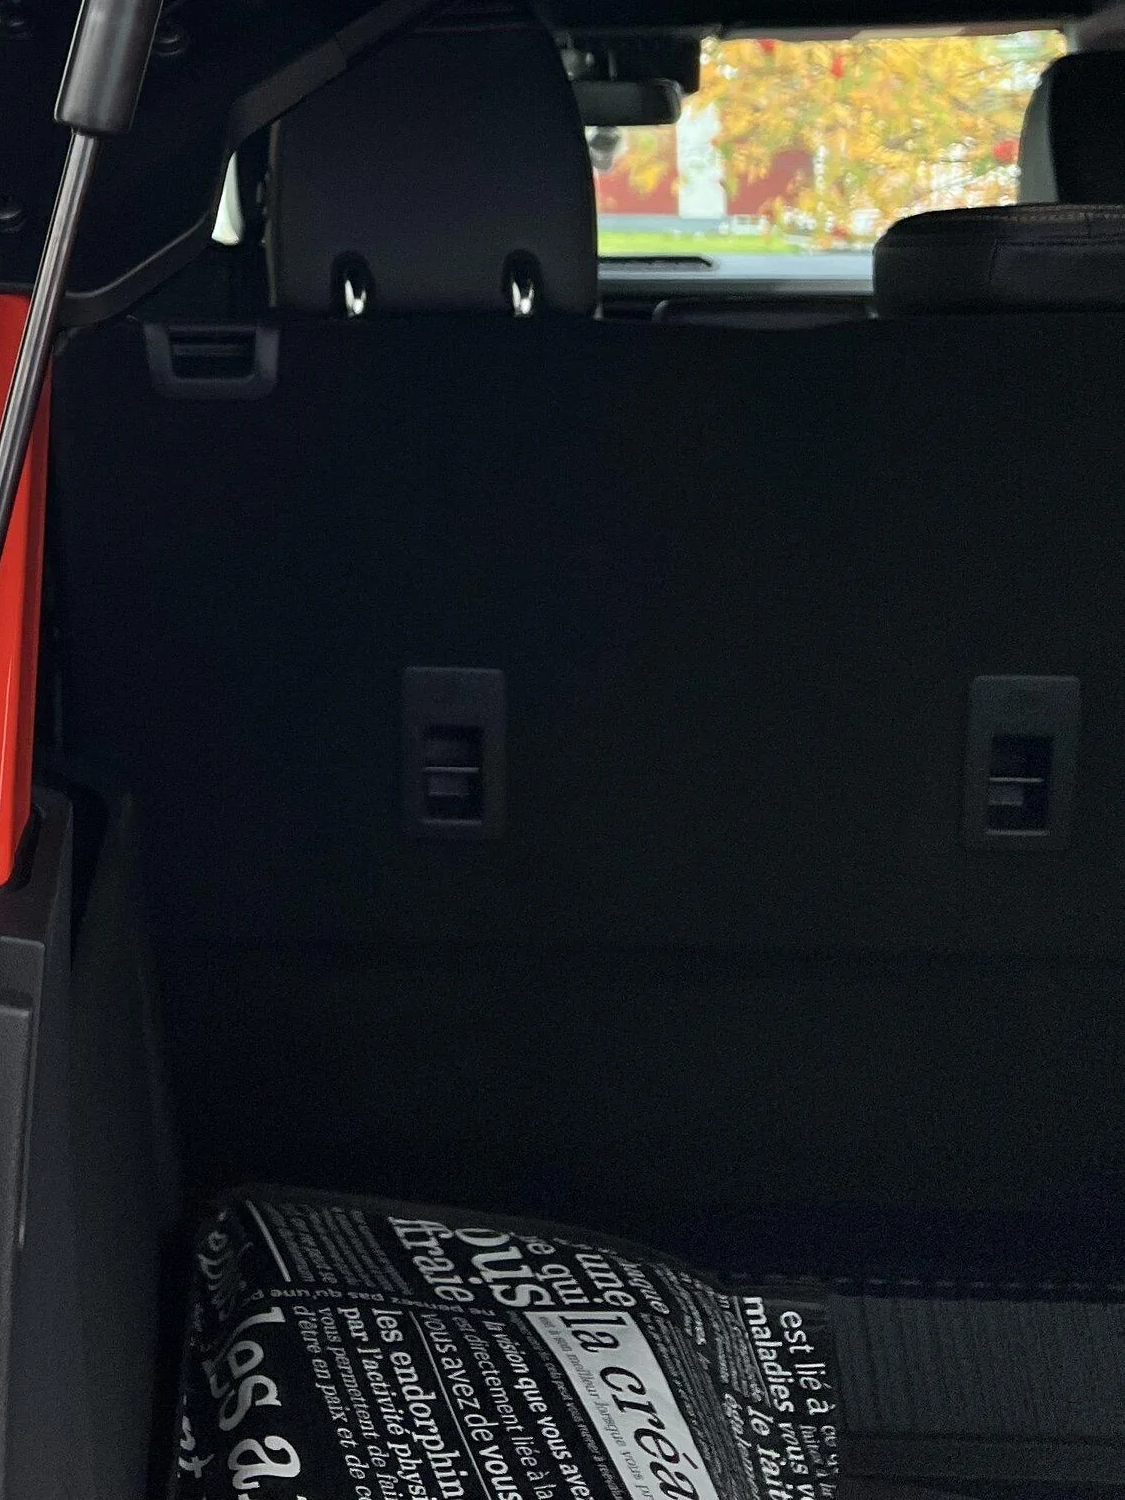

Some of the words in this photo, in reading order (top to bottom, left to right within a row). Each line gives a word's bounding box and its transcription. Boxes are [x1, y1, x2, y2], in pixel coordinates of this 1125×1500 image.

[535, 1263, 605, 1305] qui
[292, 1305, 322, 1354] d'être
[318, 1307, 343, 1343] vous
[420, 1313, 458, 1354] vous
[560, 1315, 628, 1353] la
[779, 1310, 815, 1354] est
[312, 1358, 332, 1379] en
[336, 1306, 369, 1342] par
[356, 1347, 411, 1436] l'activité
[441, 1358, 482, 1410] avez
[463, 1334, 526, 1433] directement
[742, 1296, 795, 1413] maladies
[778, 1422, 810, 1475] vous
[794, 1362, 832, 1391] lié
[315, 1382, 351, 1423] paix
[327, 1347, 381, 1439] permettent
[371, 1307, 405, 1344] les
[390, 1351, 469, 1500] endorphin
[492, 1333, 530, 1375] vision
[513, 1376, 548, 1412] que
[536, 1415, 573, 1460] vous
[806, 1397, 836, 1416] à
[336, 1427, 359, 1448] et
[464, 1414, 499, 1442] de
[567, 1353, 601, 1402] meilleur
[594, 1401, 626, 1447] lorsque
[621, 1450, 645, 1481] vous
[747, 1405, 774, 1436] le
[227, 1435, 308, 1500] a
[344, 1454, 370, 1480] de
[366, 1444, 390, 1467] de
[510, 1436, 541, 1466] liée
[479, 1445, 523, 1500] vous
[527, 1470, 551, 1481] à
[533, 1483, 557, 1500] la
